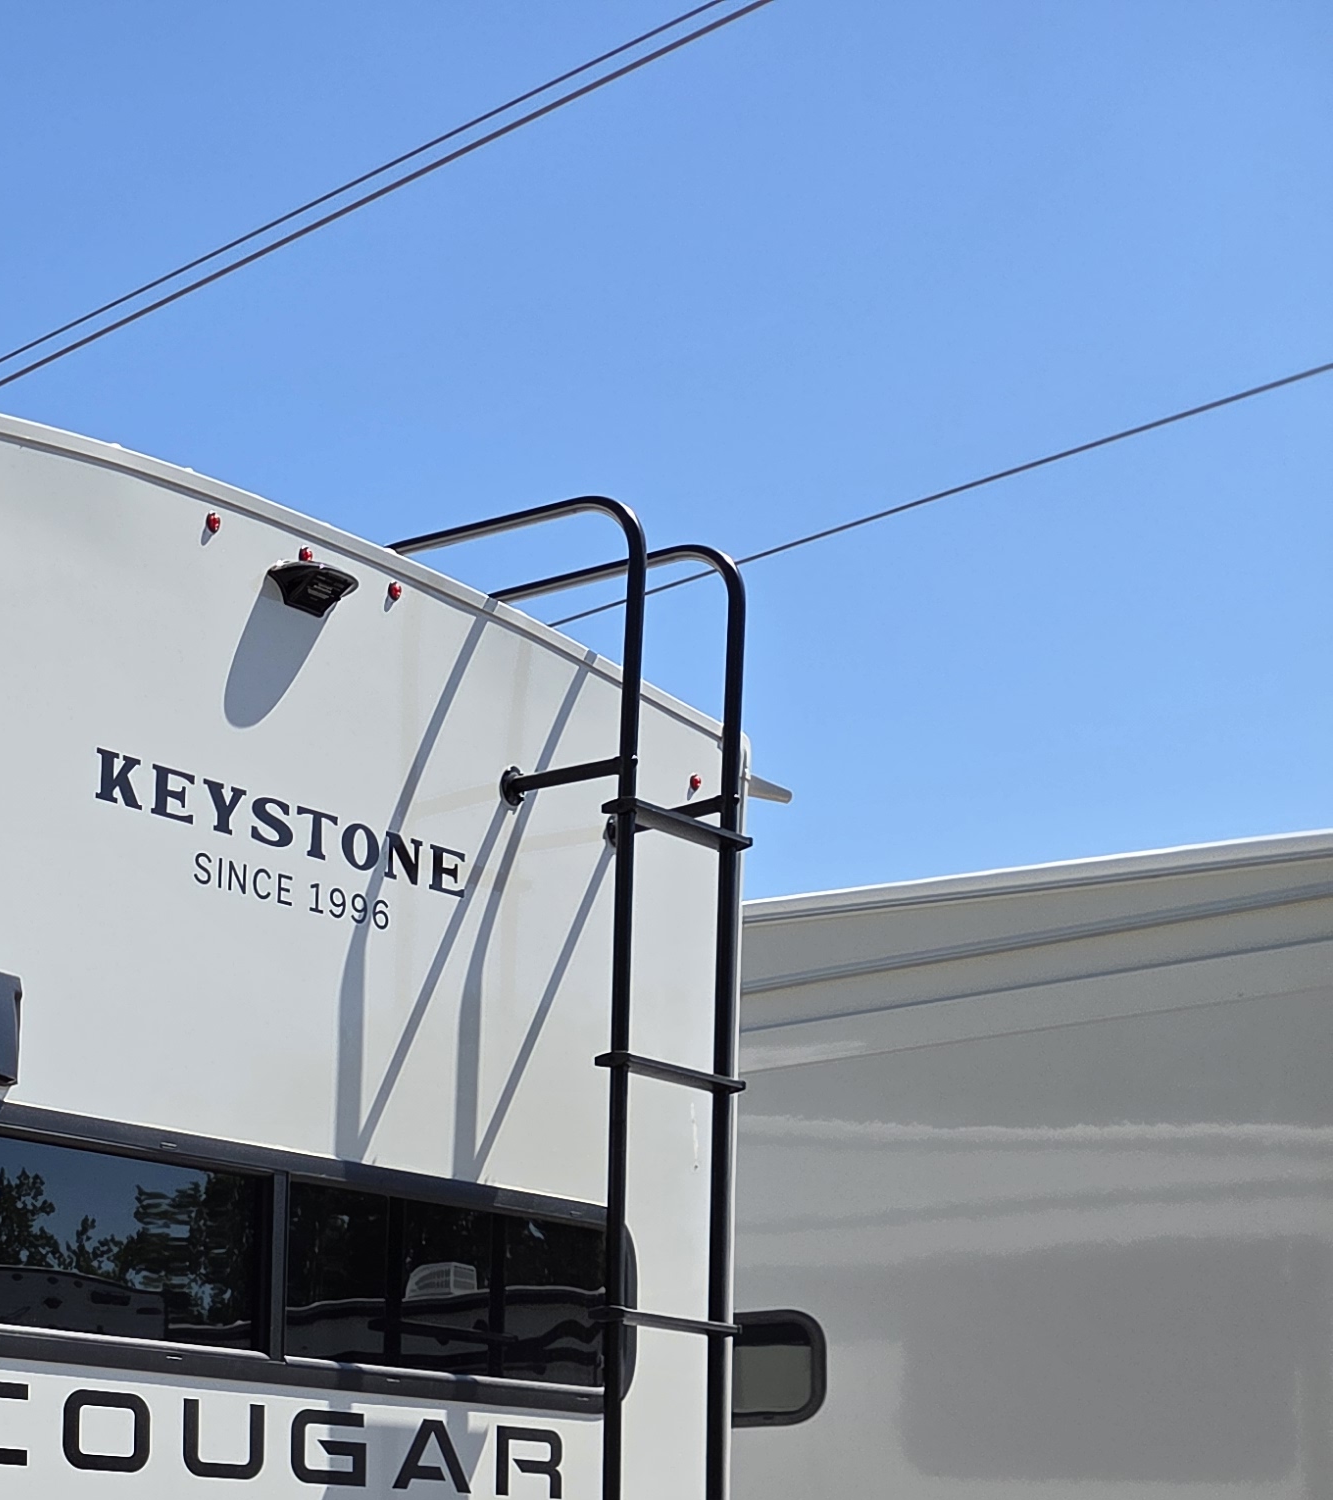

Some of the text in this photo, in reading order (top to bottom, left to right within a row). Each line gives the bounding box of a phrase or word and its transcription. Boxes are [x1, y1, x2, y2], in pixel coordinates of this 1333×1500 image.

[95, 747, 466, 898] KEYSTONE
[193, 852, 390, 930] SINCE 1996
